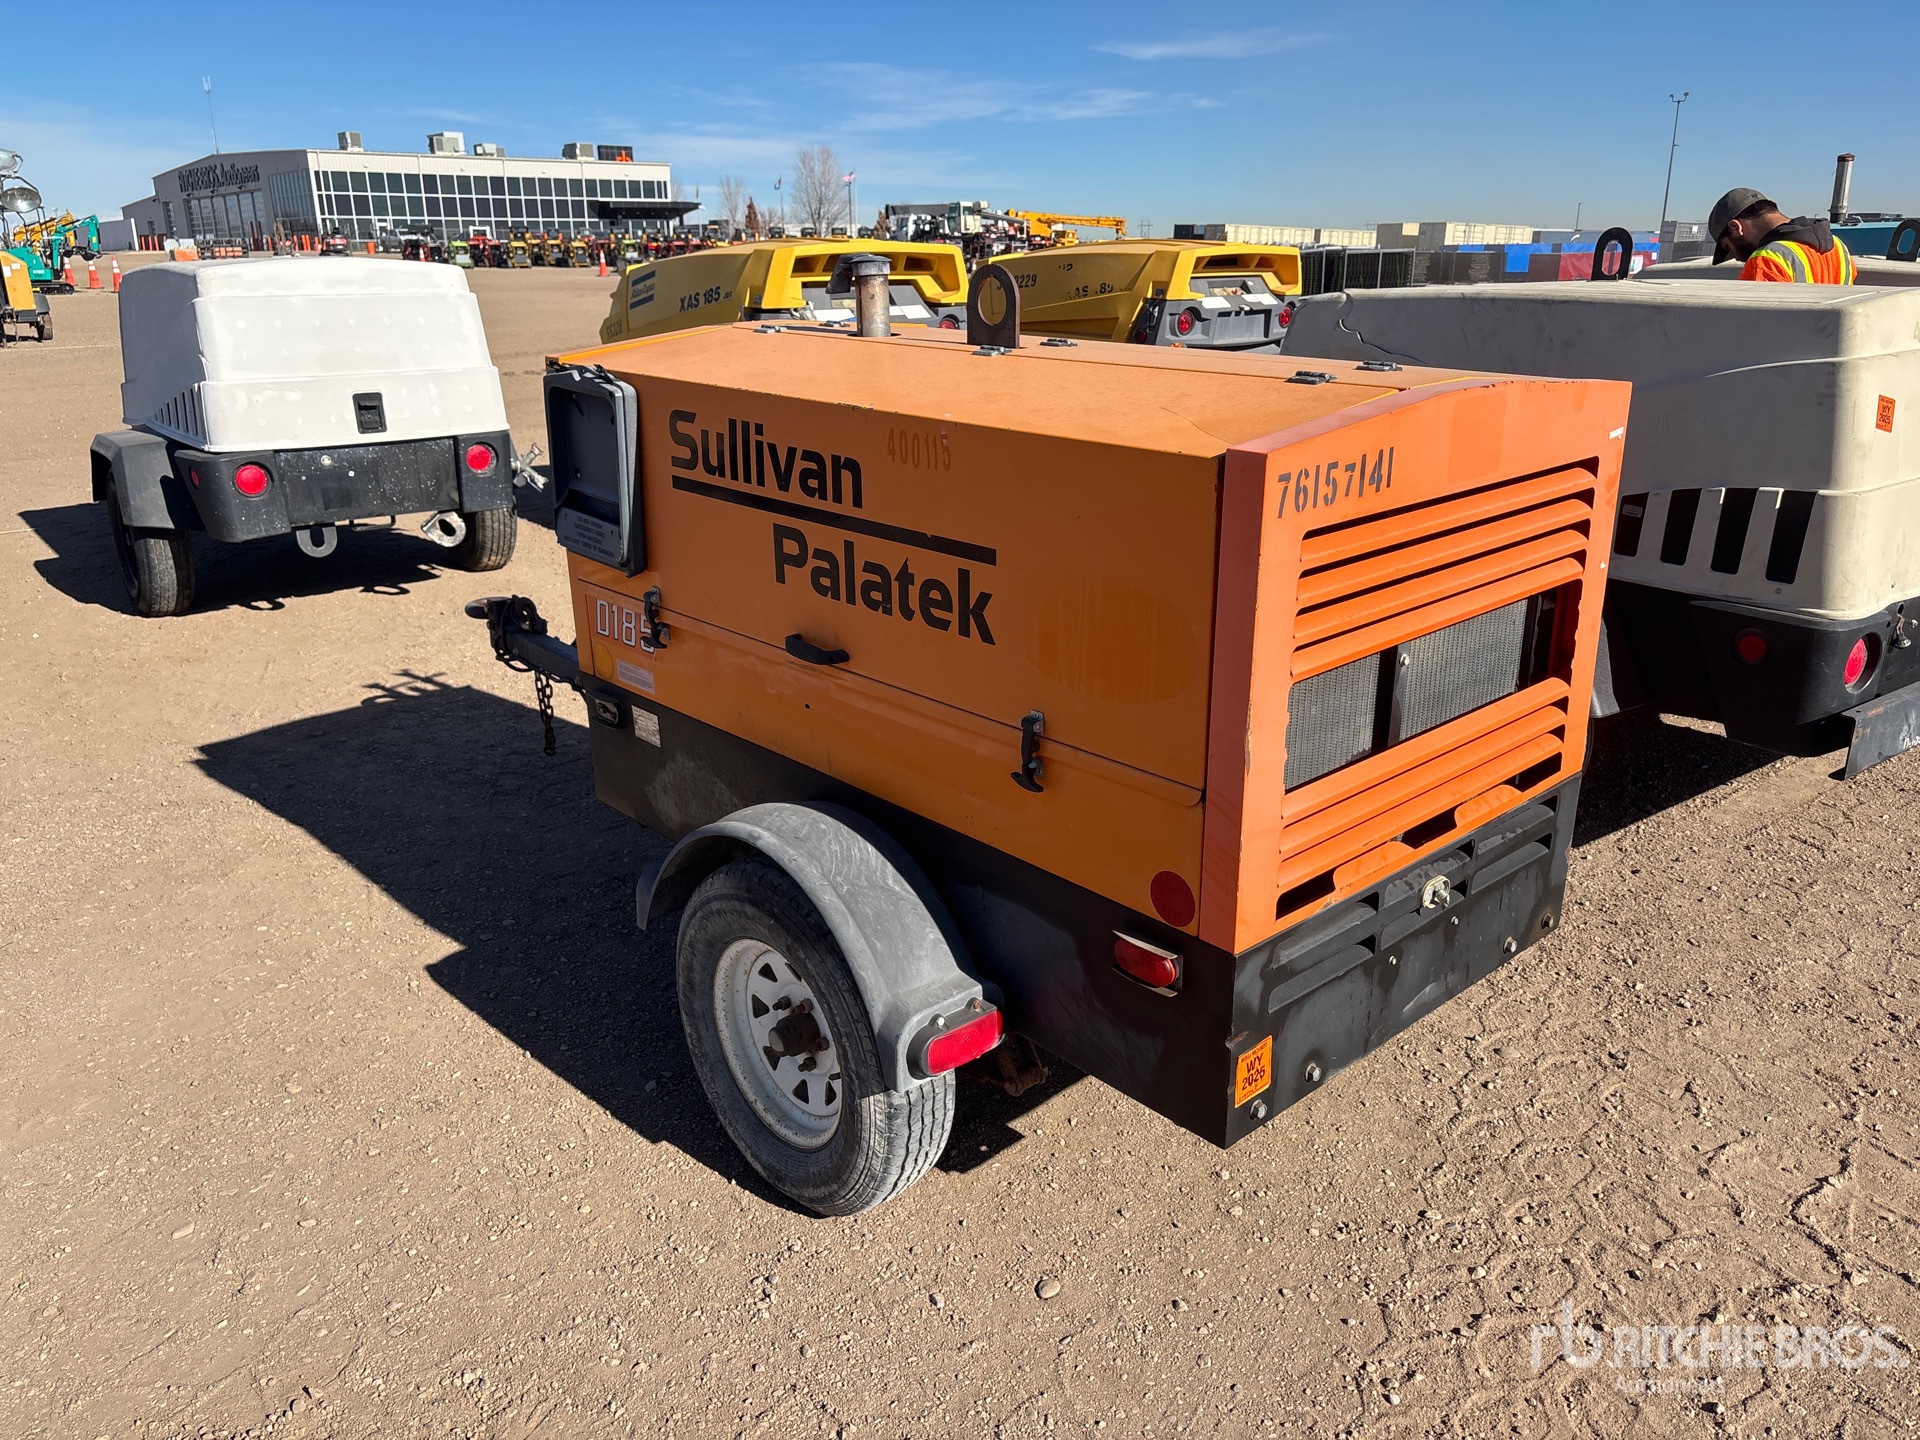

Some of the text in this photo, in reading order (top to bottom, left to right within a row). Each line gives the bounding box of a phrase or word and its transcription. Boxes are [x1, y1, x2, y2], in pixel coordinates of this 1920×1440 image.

[679, 291, 700, 313] XAS
[703, 285, 720, 305] 185
[668, 408, 863, 510] Sullivan
[886, 427, 951, 472] 400115
[1277, 446, 1395, 519] 76157141
[772, 522, 997, 647] Palatek
[1241, 1064, 1266, 1091] 2025
[1246, 1053, 1263, 1074] WY
